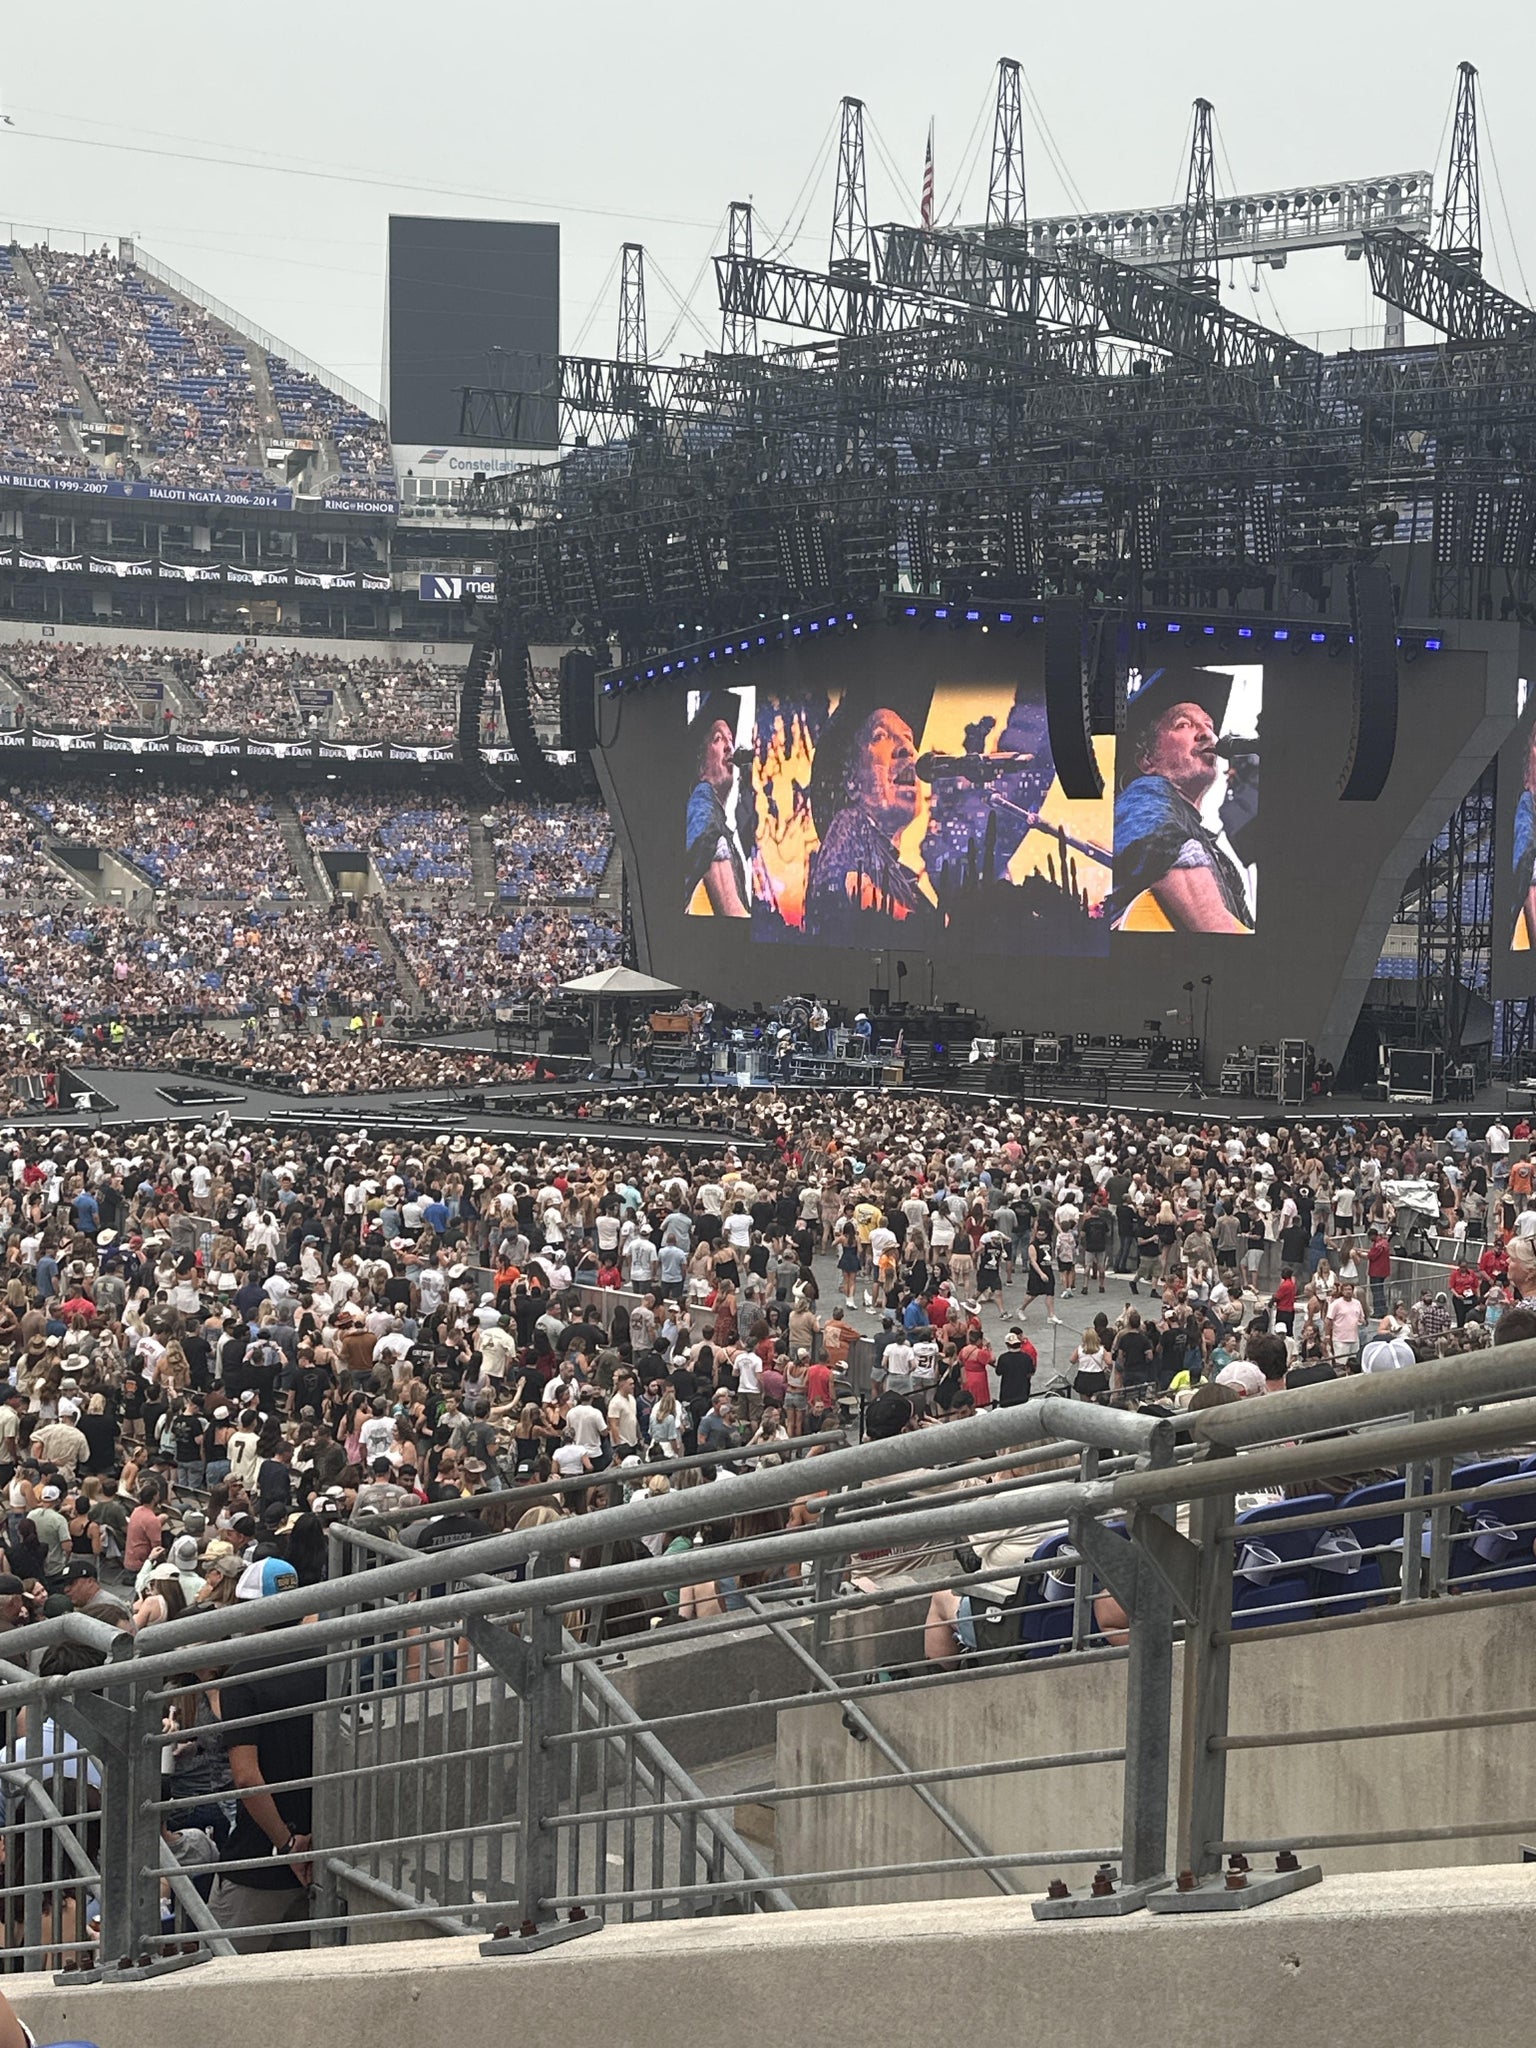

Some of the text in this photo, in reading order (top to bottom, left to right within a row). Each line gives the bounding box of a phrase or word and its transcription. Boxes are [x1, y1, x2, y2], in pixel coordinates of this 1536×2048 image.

[449, 457, 522, 473] Constellatio
[13, 477, 51, 489] BILLICK
[54, 480, 108, 494] 1999-2007
[149, 488, 277, 507] HALOTI NGATA 2006-2014
[325, 500, 395, 513] RING HONOR
[3, 735, 25, 746] DUNN
[918, 1355, 933, 1369] 21
[235, 1440, 245, 1463] 7
